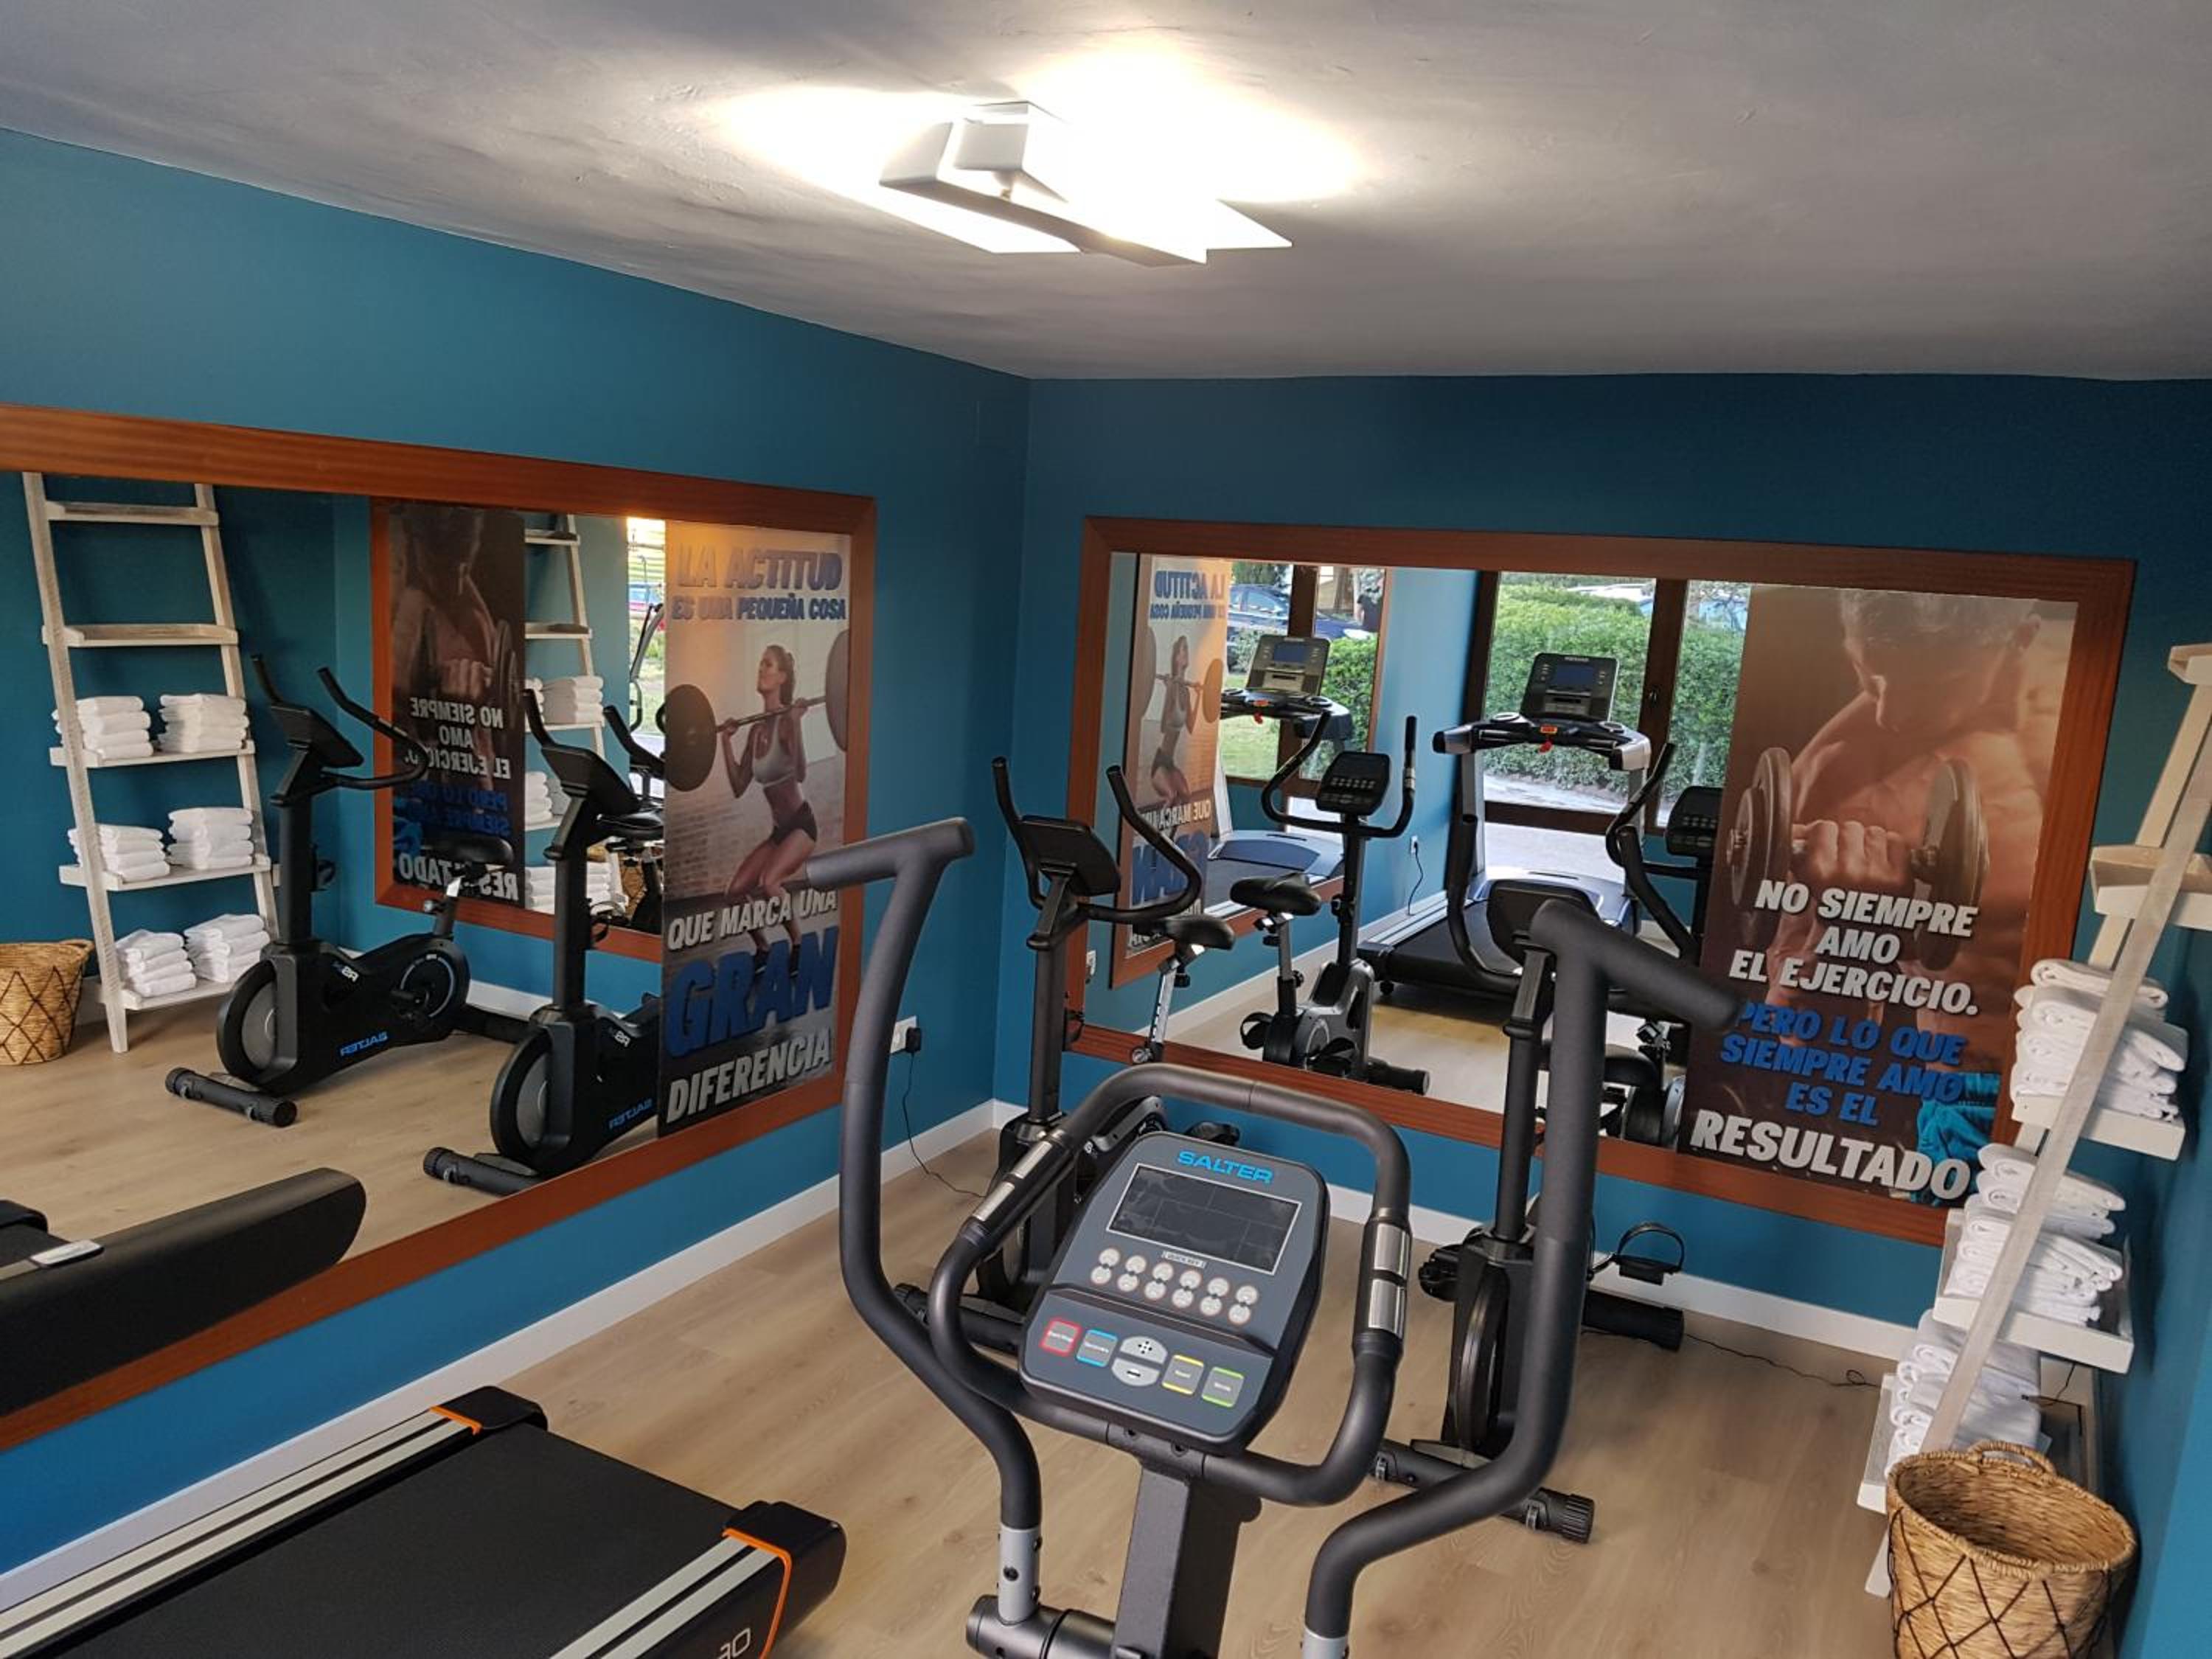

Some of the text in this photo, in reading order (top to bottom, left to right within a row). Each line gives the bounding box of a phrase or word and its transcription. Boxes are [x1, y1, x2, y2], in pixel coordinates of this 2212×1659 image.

[678, 543, 844, 591] LA ACTITUD
[671, 593, 846, 621] ES UNA PEQUEÑA COSA
[668, 889, 838, 951] QUE MARCA UNA
[1754, 880, 1979, 937] NO SIEMPRE
[1815, 926, 1900, 964] AMO
[666, 925, 839, 1058] GRAN
[1729, 949, 1980, 1015] EL EJERCICIO.
[1736, 1002, 1969, 1065] PERO LO QUE
[666, 1025, 832, 1124] DIFERENCIA
[1721, 1033, 1966, 1105] SIEMPRE AMO
[1785, 1082, 1879, 1126] ES EL
[1177, 1150, 1273, 1185] SALTER
[1689, 1108, 1972, 1200] RESULTADO
